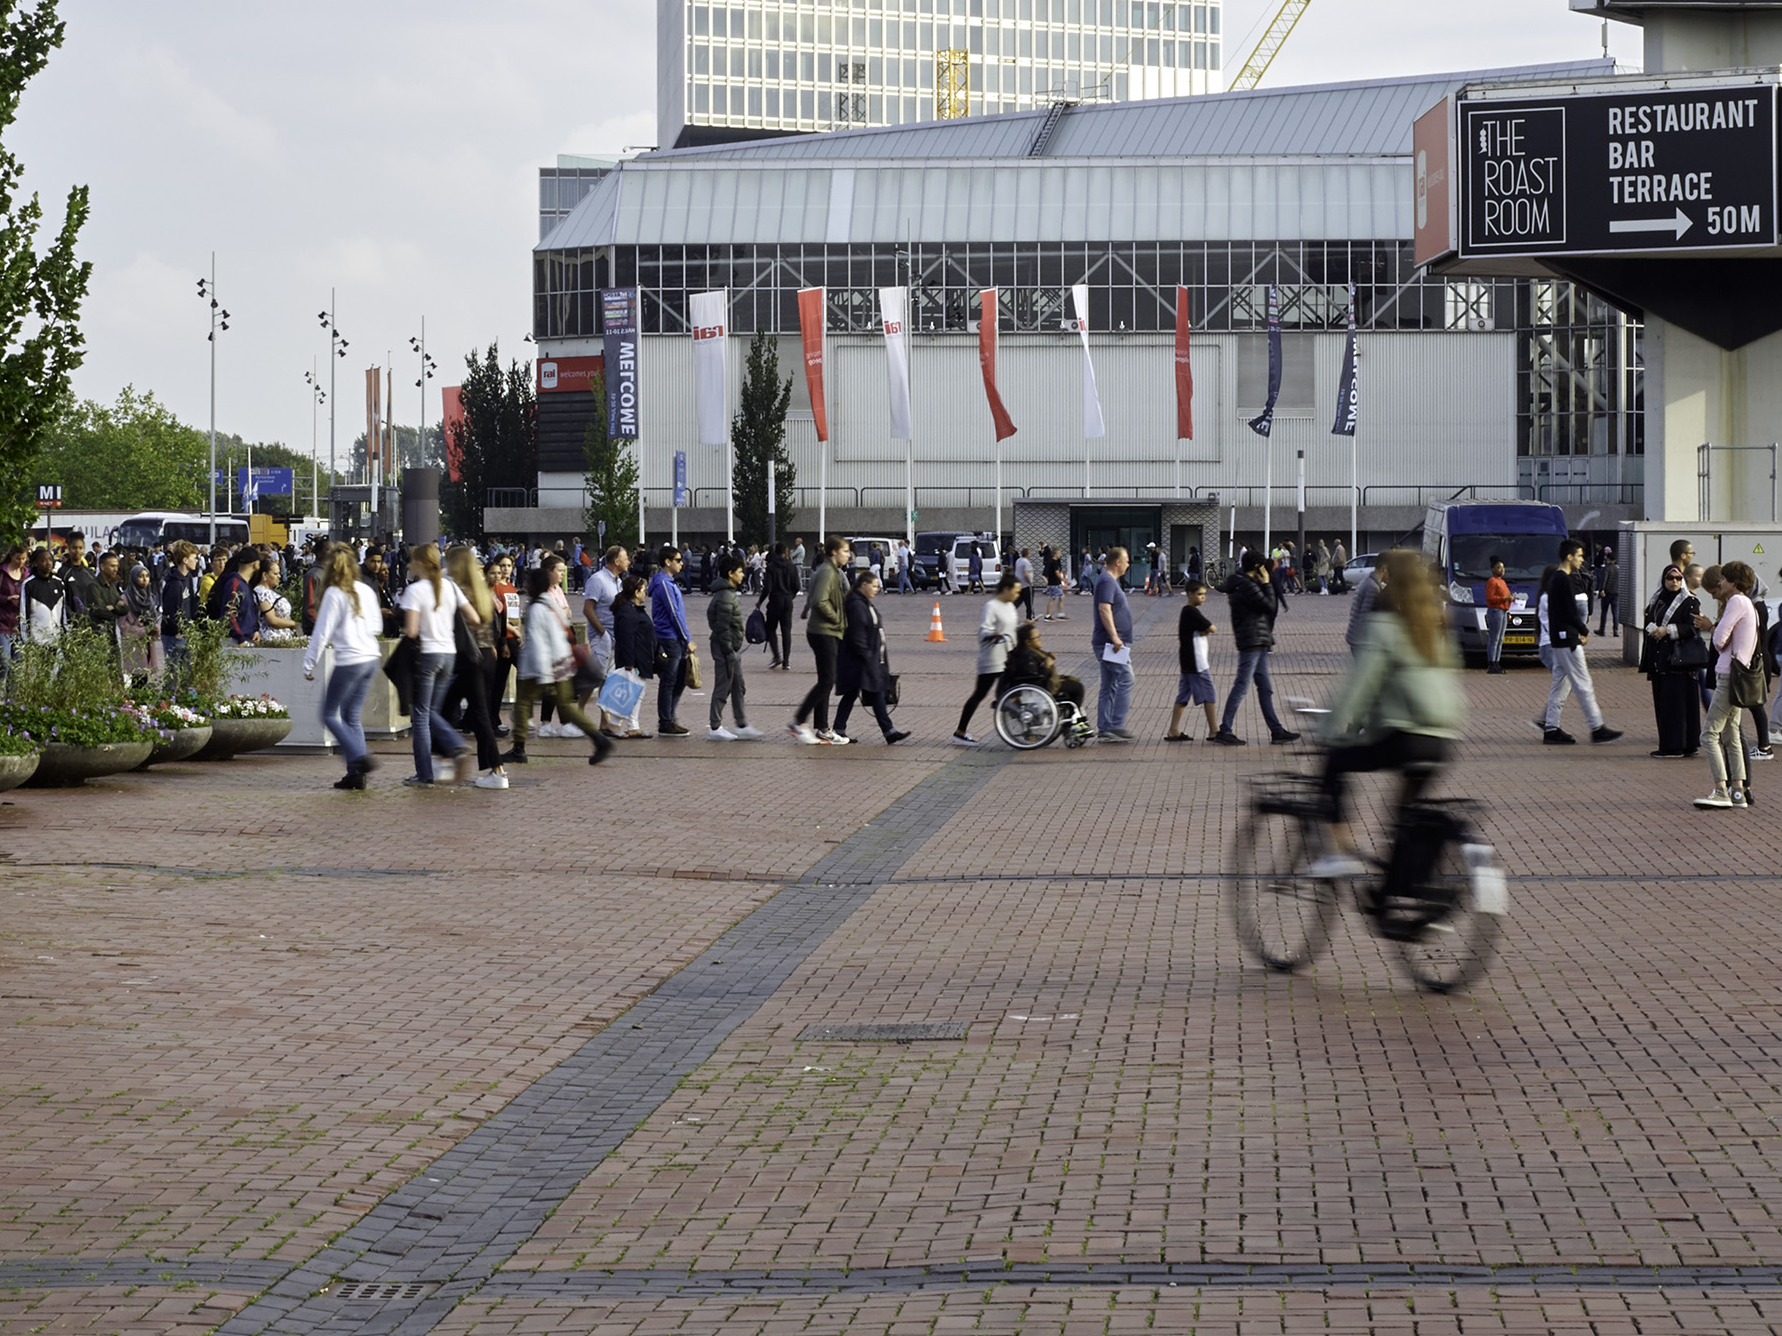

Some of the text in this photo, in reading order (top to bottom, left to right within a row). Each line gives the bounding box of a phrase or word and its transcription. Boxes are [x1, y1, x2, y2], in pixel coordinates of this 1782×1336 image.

[1608, 99, 1758, 135] RESTAURANT
[1483, 119, 1526, 157] THE
[1609, 140, 1655, 170] BAR
[1485, 157, 1558, 197] ROAST
[1609, 172, 1713, 204] TERRACE
[1485, 197, 1550, 236] ROOM
[1707, 204, 1761, 235] 50M
[543, 369, 555, 378] rai
